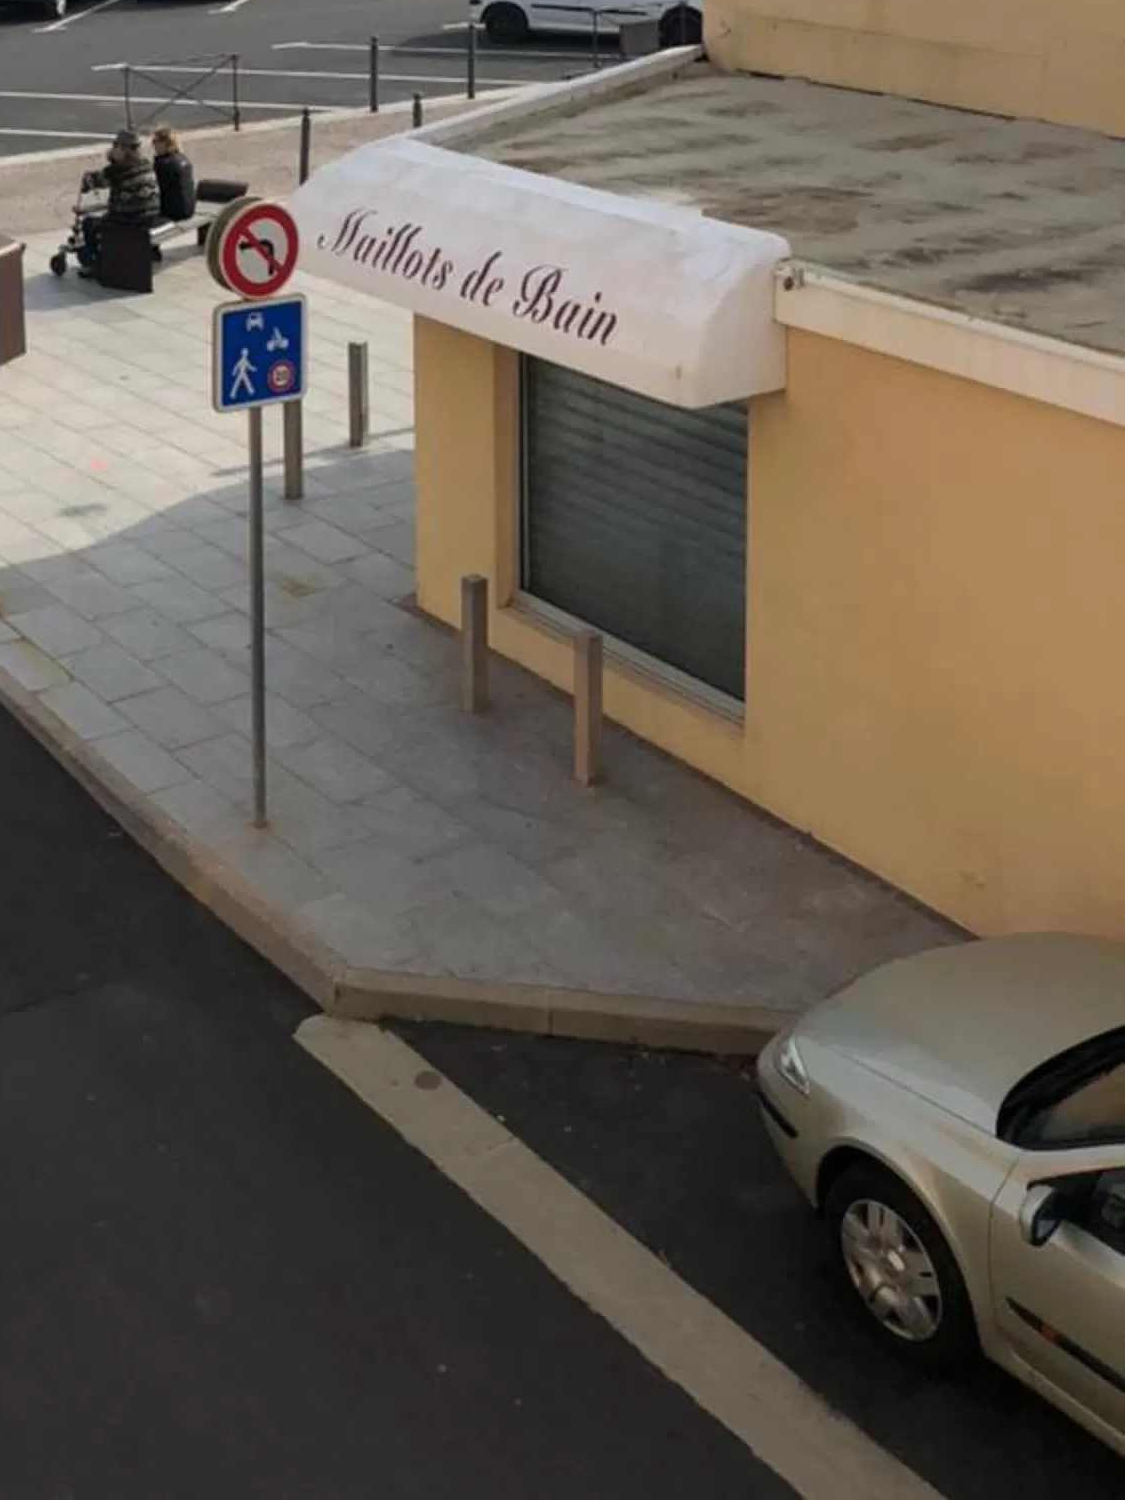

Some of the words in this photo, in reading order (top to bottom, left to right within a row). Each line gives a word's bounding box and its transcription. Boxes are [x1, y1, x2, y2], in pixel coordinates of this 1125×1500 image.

[317, 207, 454, 290] Maillots
[460, 251, 504, 306] de
[513, 263, 617, 346] Bain
